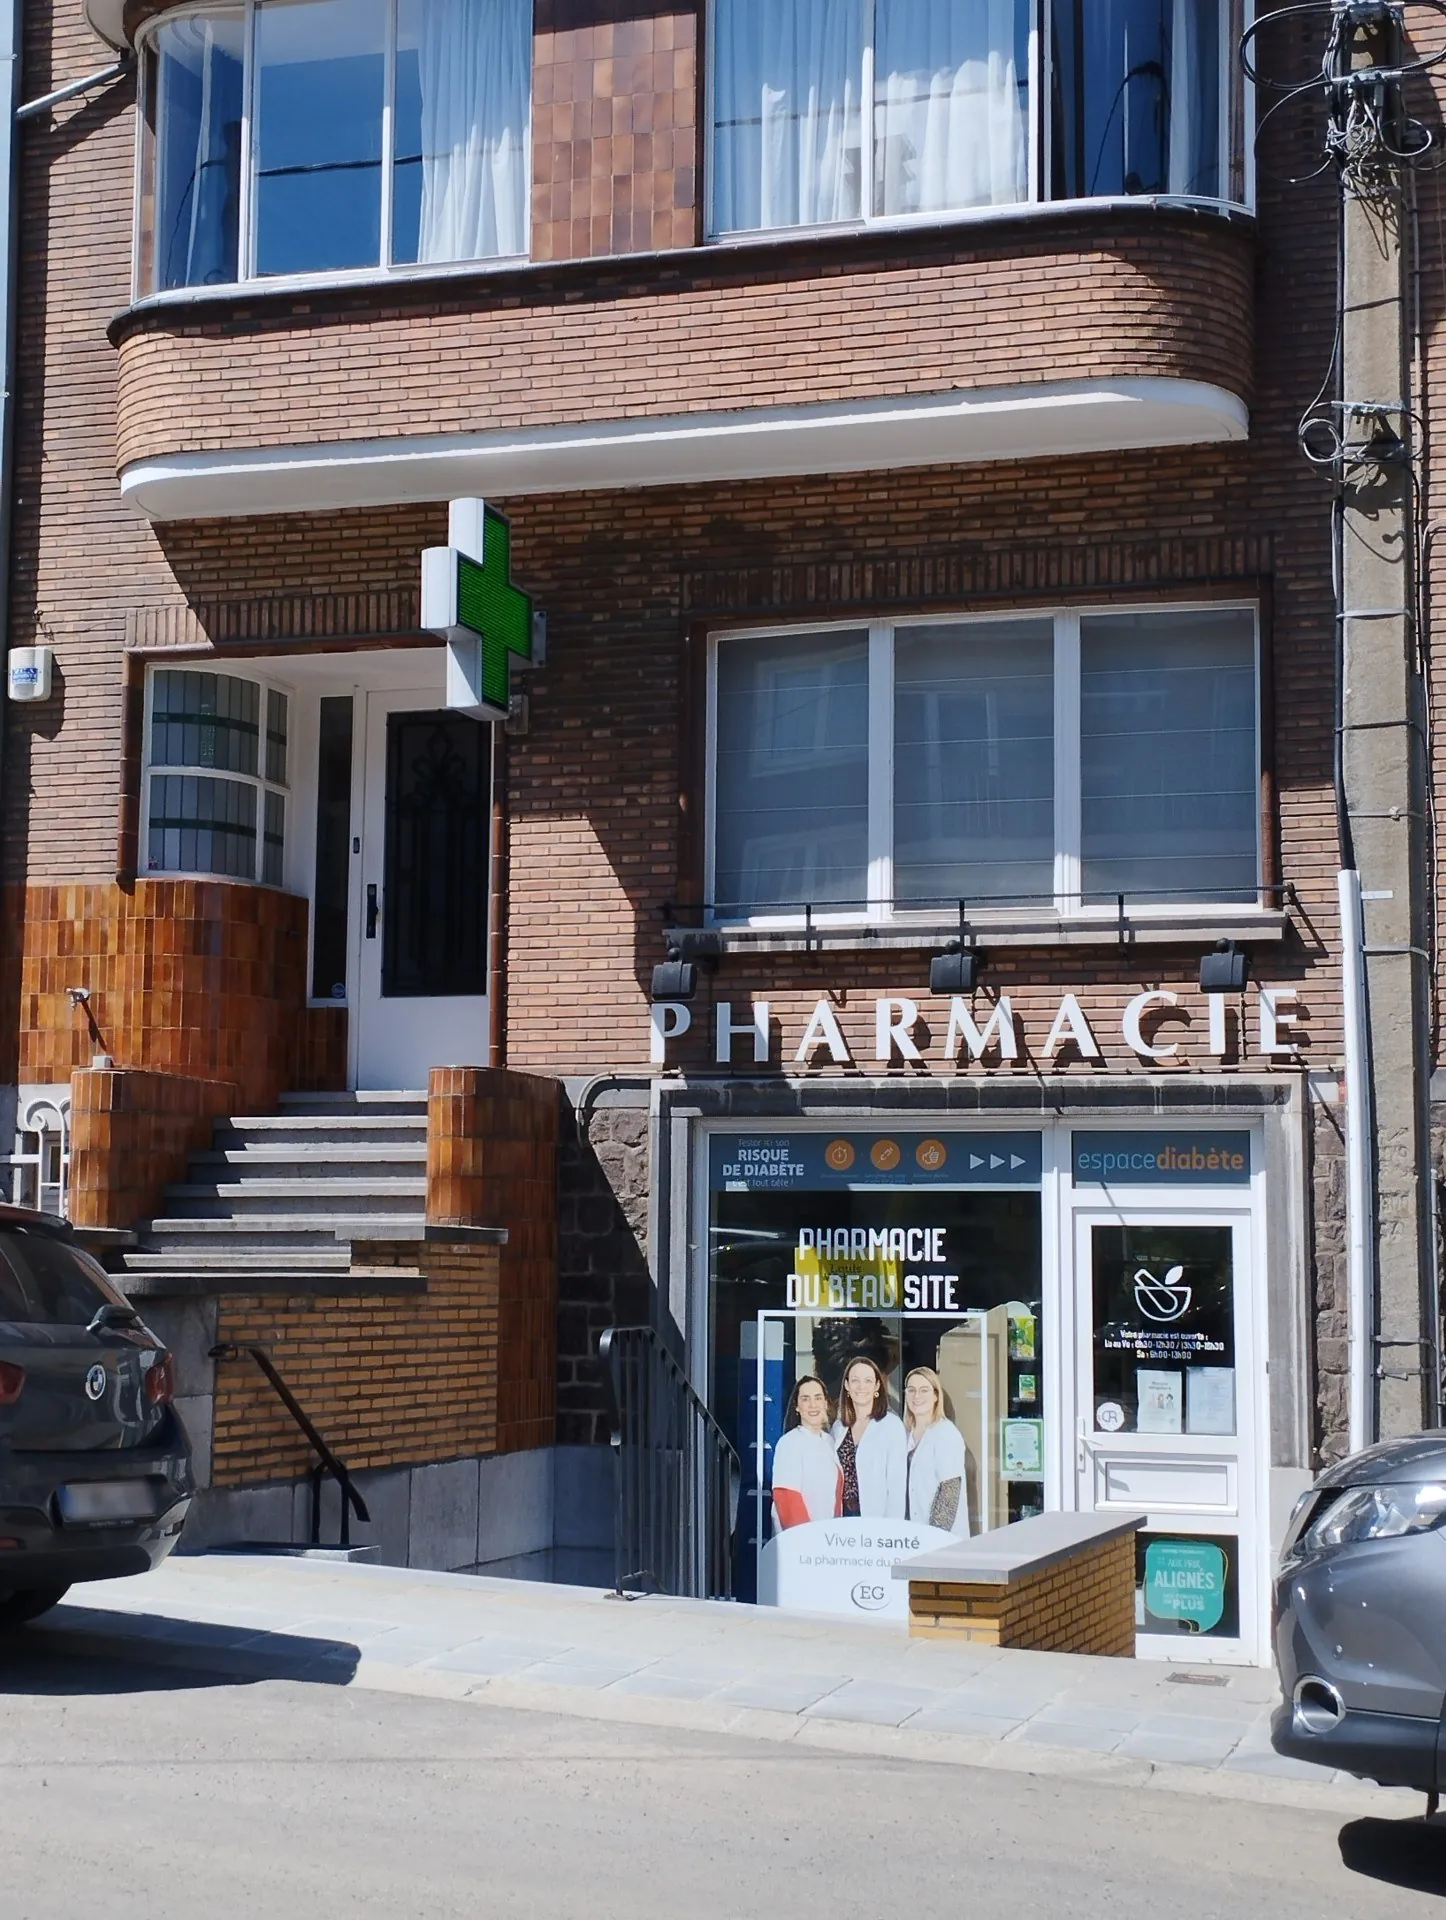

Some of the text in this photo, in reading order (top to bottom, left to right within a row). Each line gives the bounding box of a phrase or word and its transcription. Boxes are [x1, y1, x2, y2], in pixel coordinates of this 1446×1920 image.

[650, 988, 1299, 1063] PHARMACIE
[738, 1149, 789, 1162] RISQUE
[722, 1162, 804, 1176] DE DIABÈTE
[799, 1227, 947, 1262] PHARMACIE
[786, 1273, 959, 1310] DU BEAU SITE
[825, 1533, 920, 1549] Vive la santé
[799, 1554, 812, 1565] La
[815, 1556, 873, 1568] pharmacie
[876, 1557, 890, 1567] du
[1154, 1568, 1215, 1589] ALIGNÉS
[860, 1586, 885, 1600] EG
